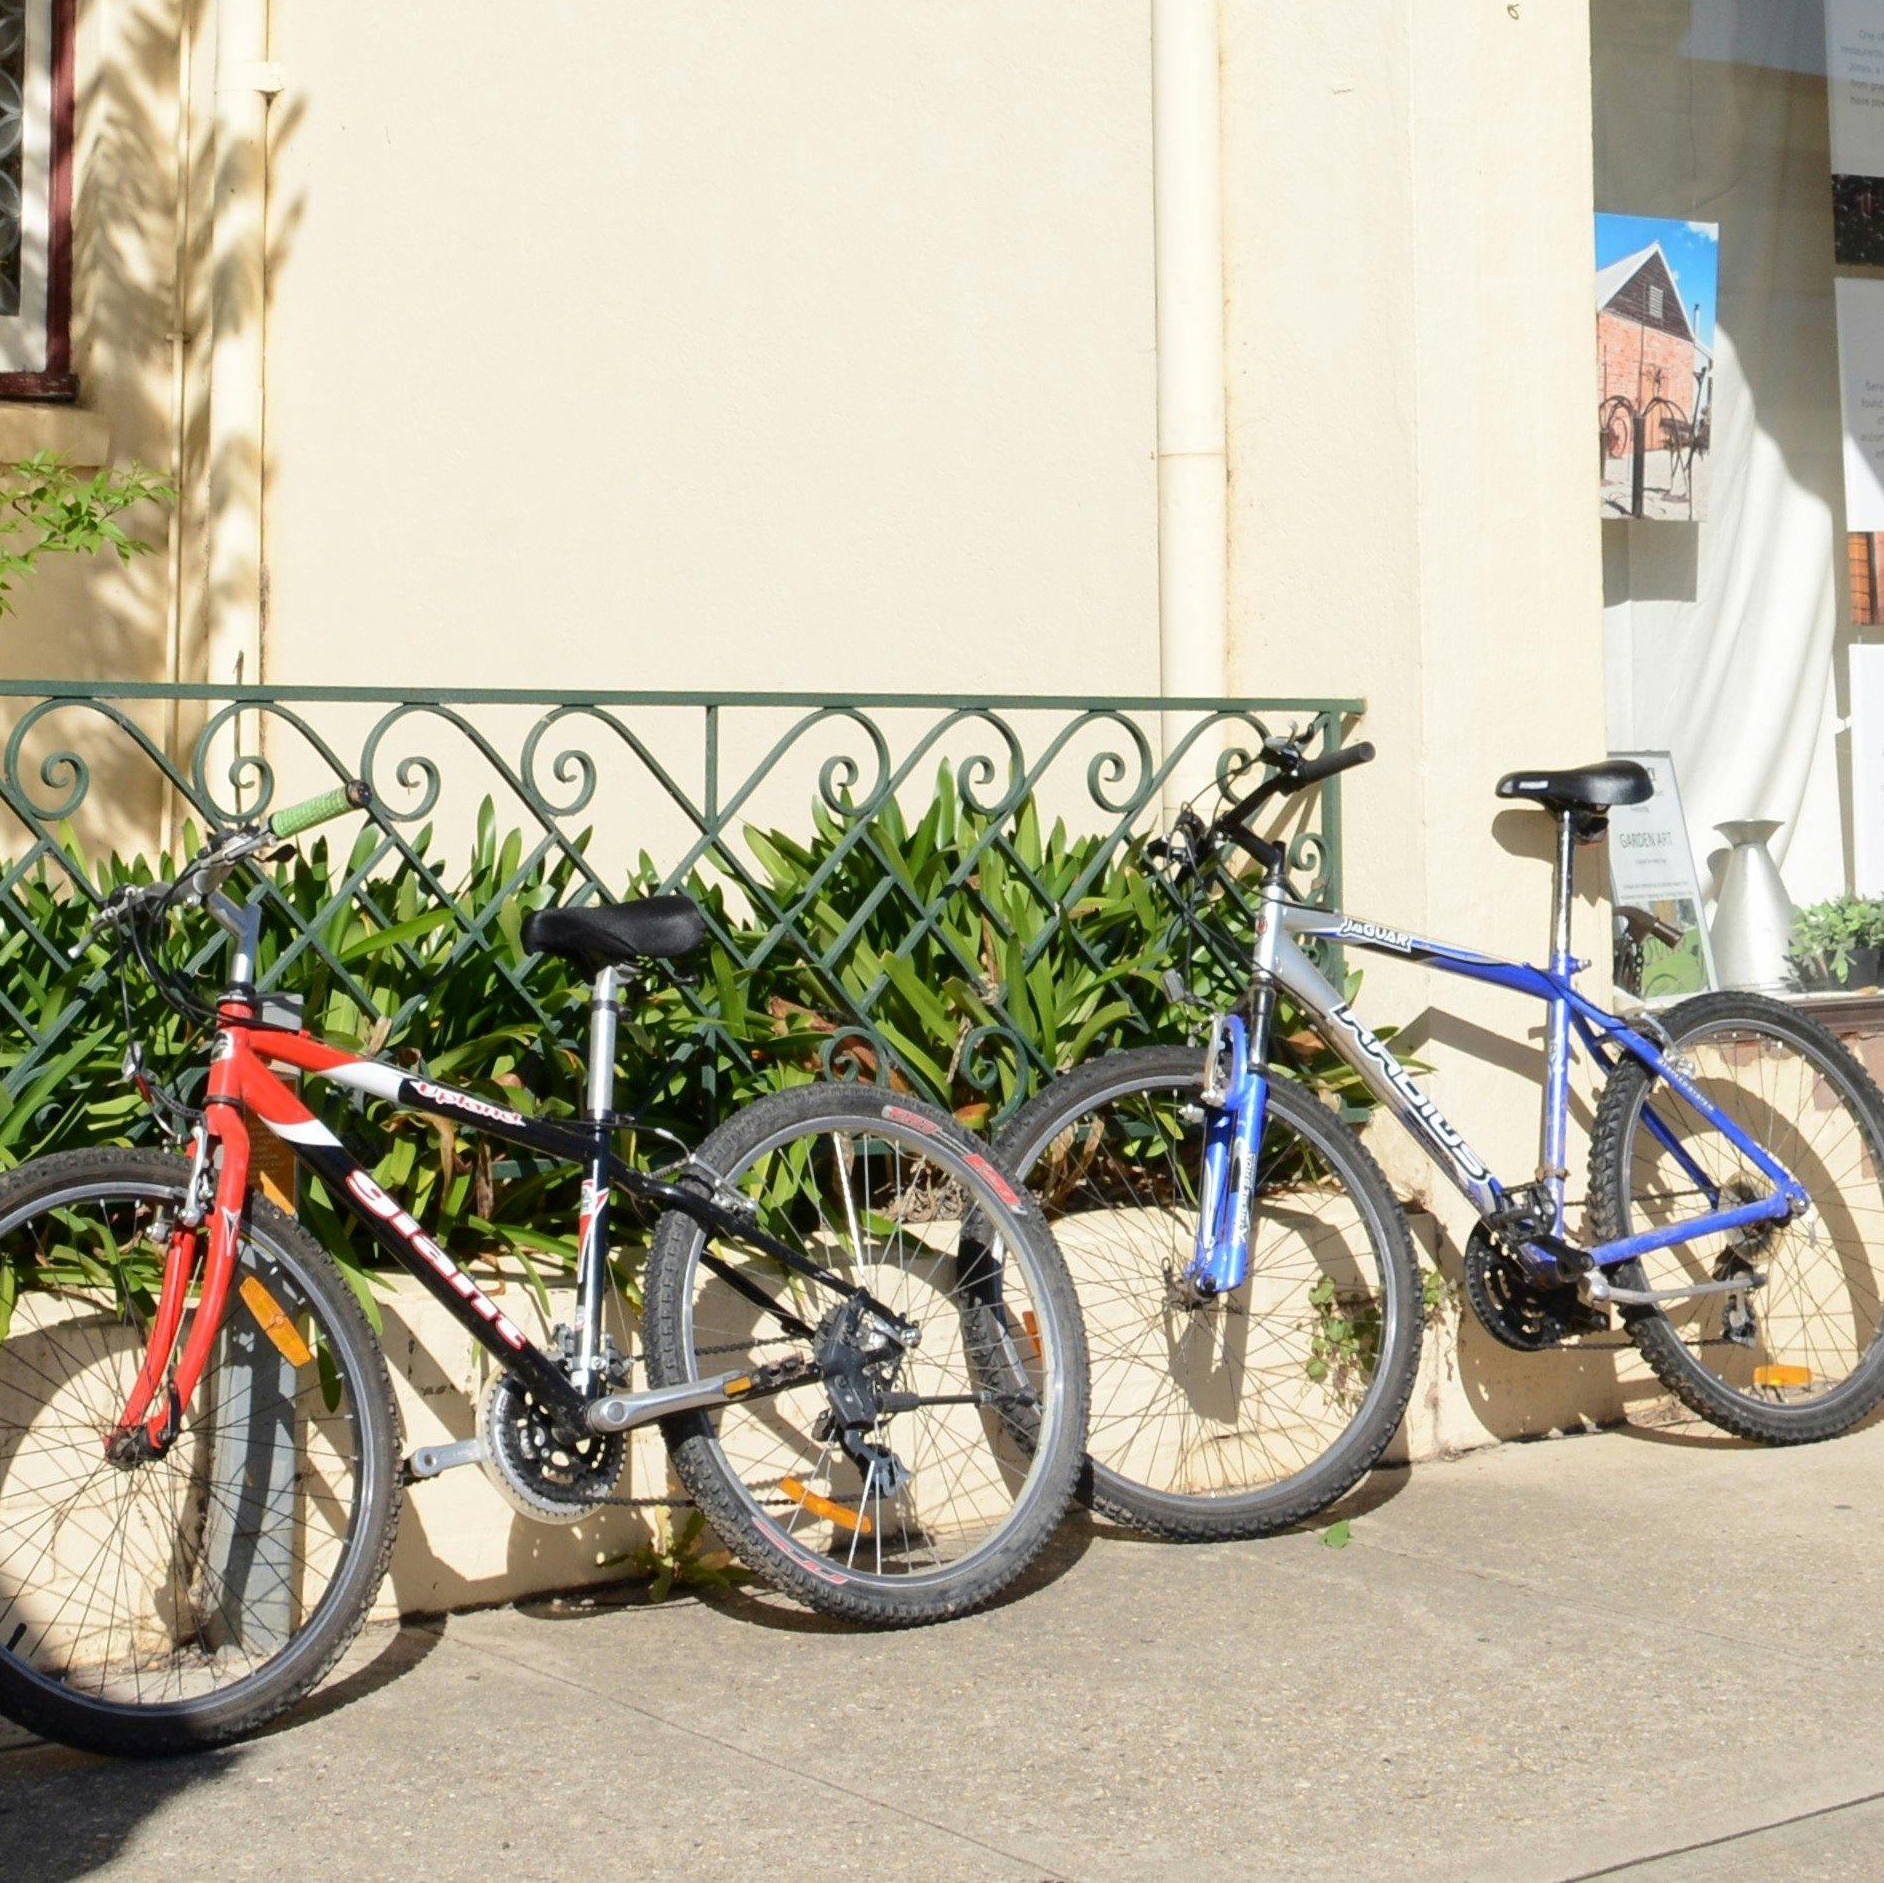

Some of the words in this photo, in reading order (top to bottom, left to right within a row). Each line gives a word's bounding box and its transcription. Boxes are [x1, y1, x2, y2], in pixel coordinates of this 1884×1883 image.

[1620, 832, 1655, 849] GARDEN
[1658, 832, 1672, 847] ART
[1343, 918, 1410, 949] JAGUAR
[415, 1079, 527, 1127] Upland
[345, 1170, 526, 1350] giant
